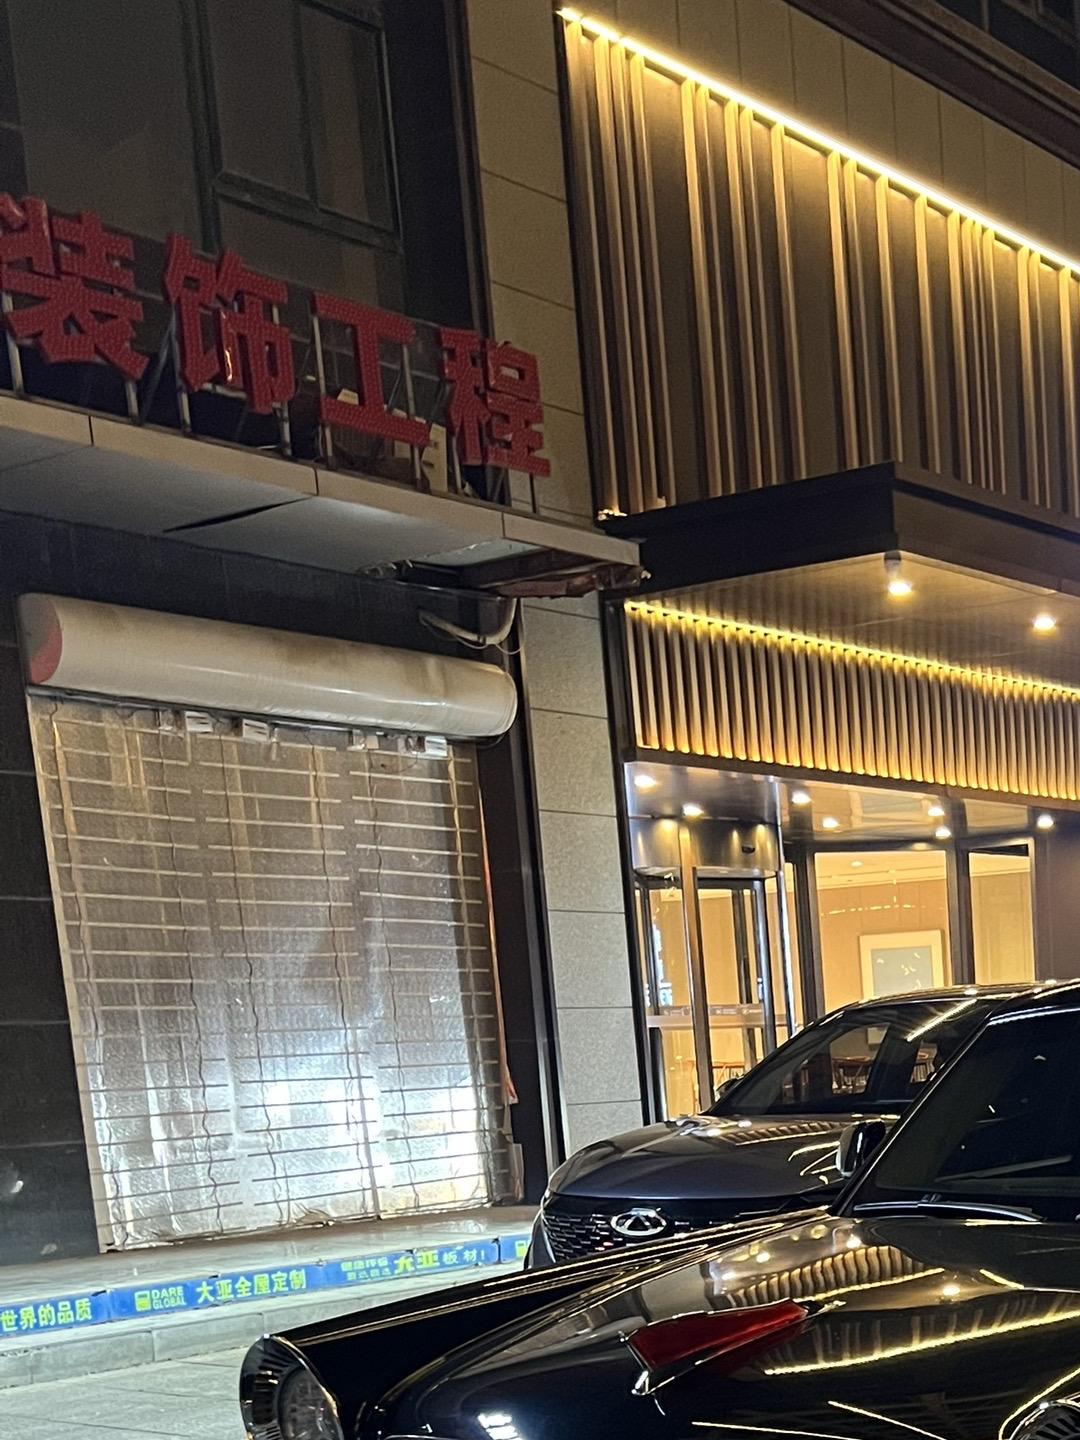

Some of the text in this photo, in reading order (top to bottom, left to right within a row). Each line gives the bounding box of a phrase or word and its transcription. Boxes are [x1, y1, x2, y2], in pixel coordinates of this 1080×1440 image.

[0, 193, 551, 478] 装饰工程
[152, 1285, 185, 1300] DARE
[152, 1296, 187, 1311] GLOBAL
[196, 1269, 307, 1304] 大亚全屋定制
[0, 1298, 92, 1332] 世界的品质
